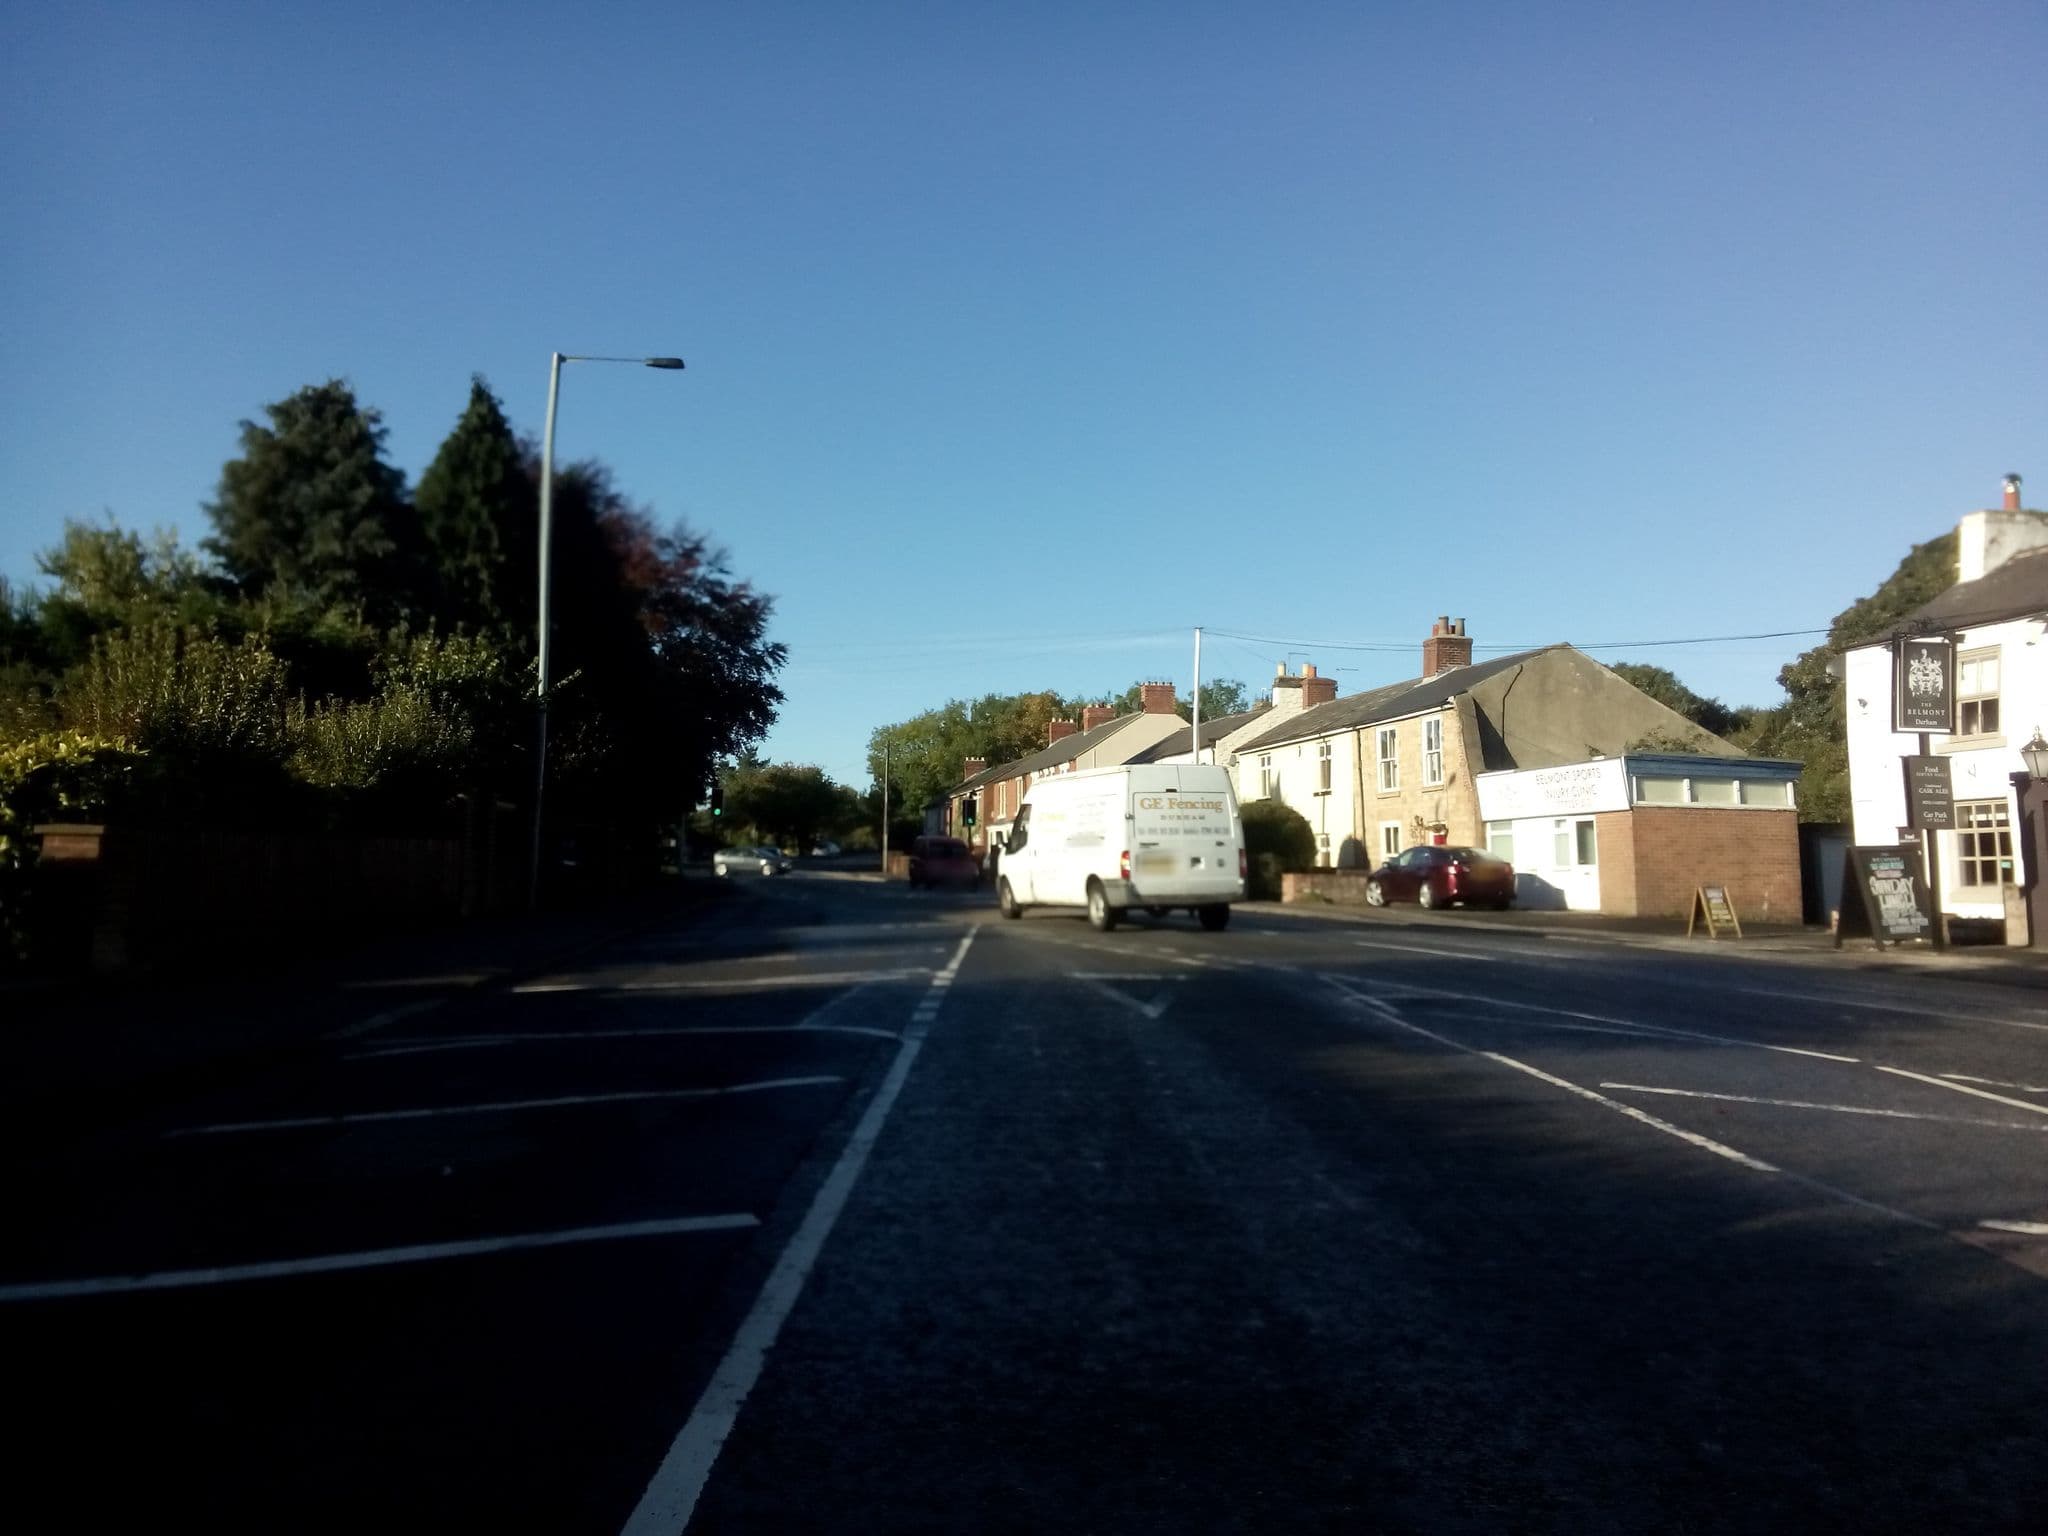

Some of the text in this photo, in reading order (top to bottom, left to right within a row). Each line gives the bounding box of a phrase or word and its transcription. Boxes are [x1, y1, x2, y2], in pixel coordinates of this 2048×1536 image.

[1907, 708, 1946, 716] BELMONT
[1915, 718, 1938, 726] Durham
[1140, 797, 1224, 813] GE Fencing
